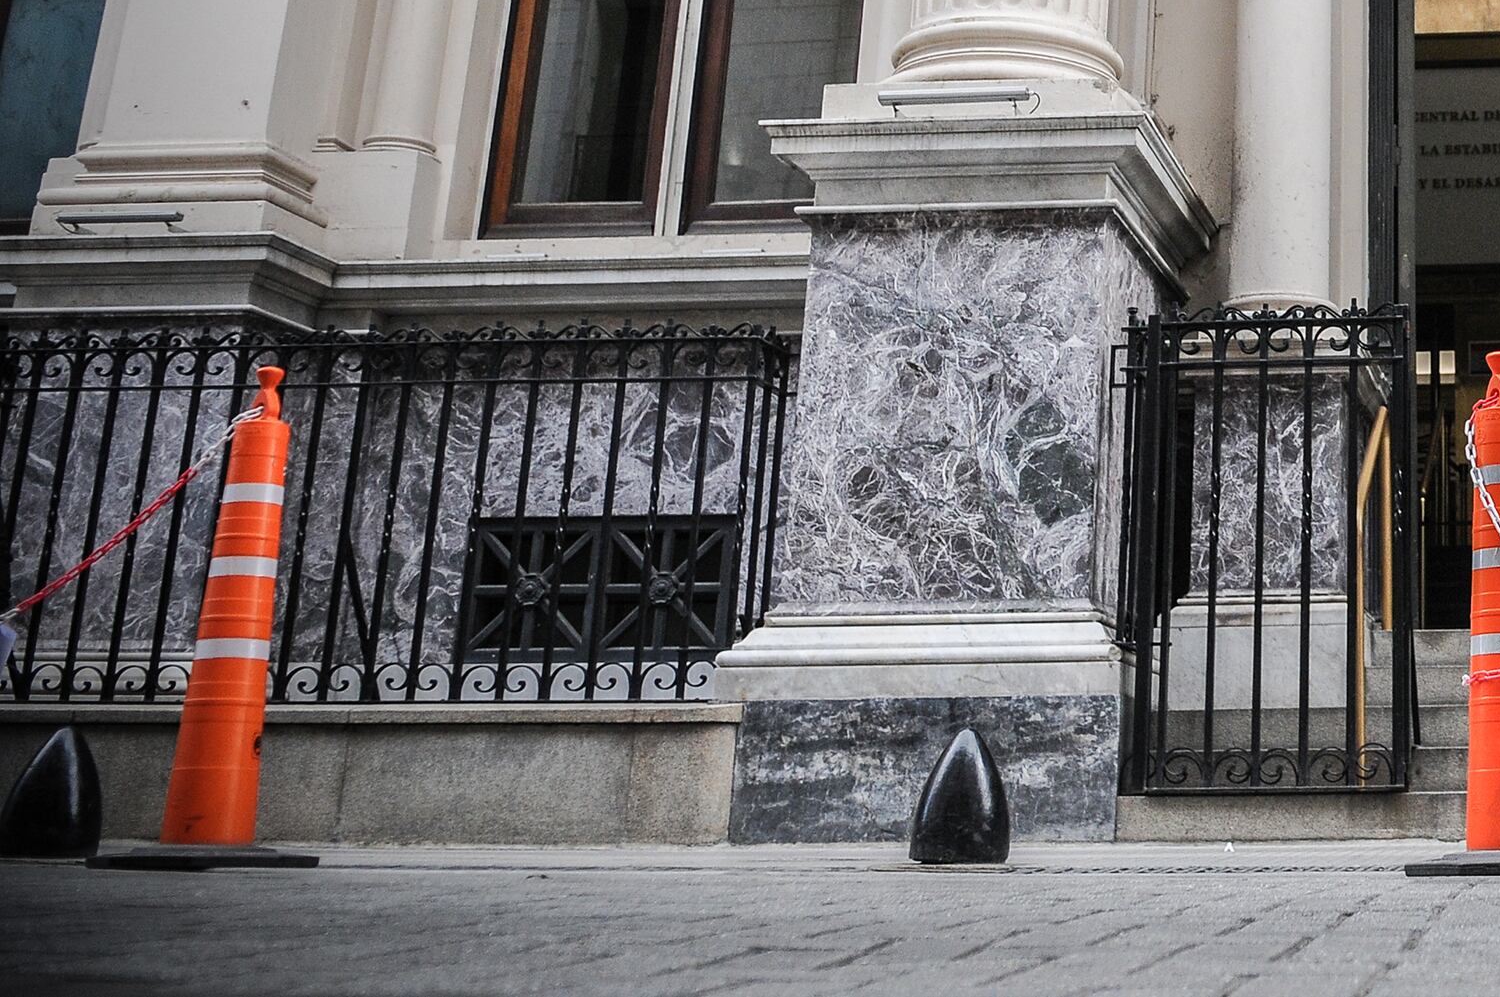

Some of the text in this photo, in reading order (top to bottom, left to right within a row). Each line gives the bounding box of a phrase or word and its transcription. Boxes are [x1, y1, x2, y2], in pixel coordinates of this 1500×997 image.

[1420, 145, 1441, 156] LA
[1418, 179, 1429, 189] Y
[1432, 178, 1452, 189] EL
